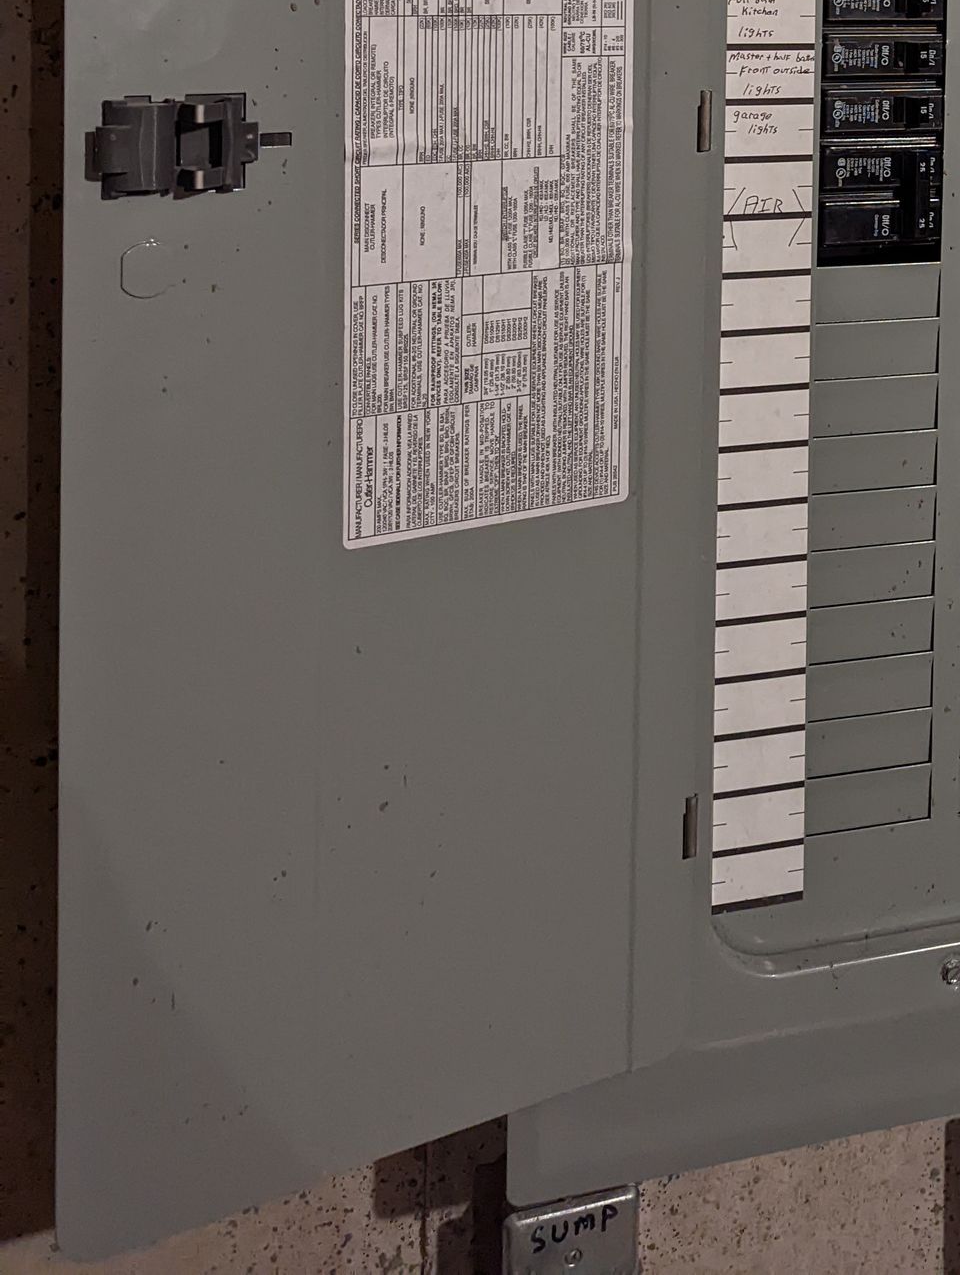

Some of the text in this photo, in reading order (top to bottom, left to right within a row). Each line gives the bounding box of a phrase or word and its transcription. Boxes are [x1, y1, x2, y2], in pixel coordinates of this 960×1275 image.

[742, 6, 778, 16] Kitchen
[739, 27, 774, 38] lights
[729, 52, 763, 61] Master
[773, 52, 791, 62] half
[739, 66, 811, 76] Front outside
[743, 84, 781, 96] lights
[733, 111, 772, 123] garage
[748, 125, 778, 135] lights
[744, 196, 783, 214] AIR
[364, 446, 374, 507] Cutler-Hammer
[530, 1203, 619, 1254] SUMP
